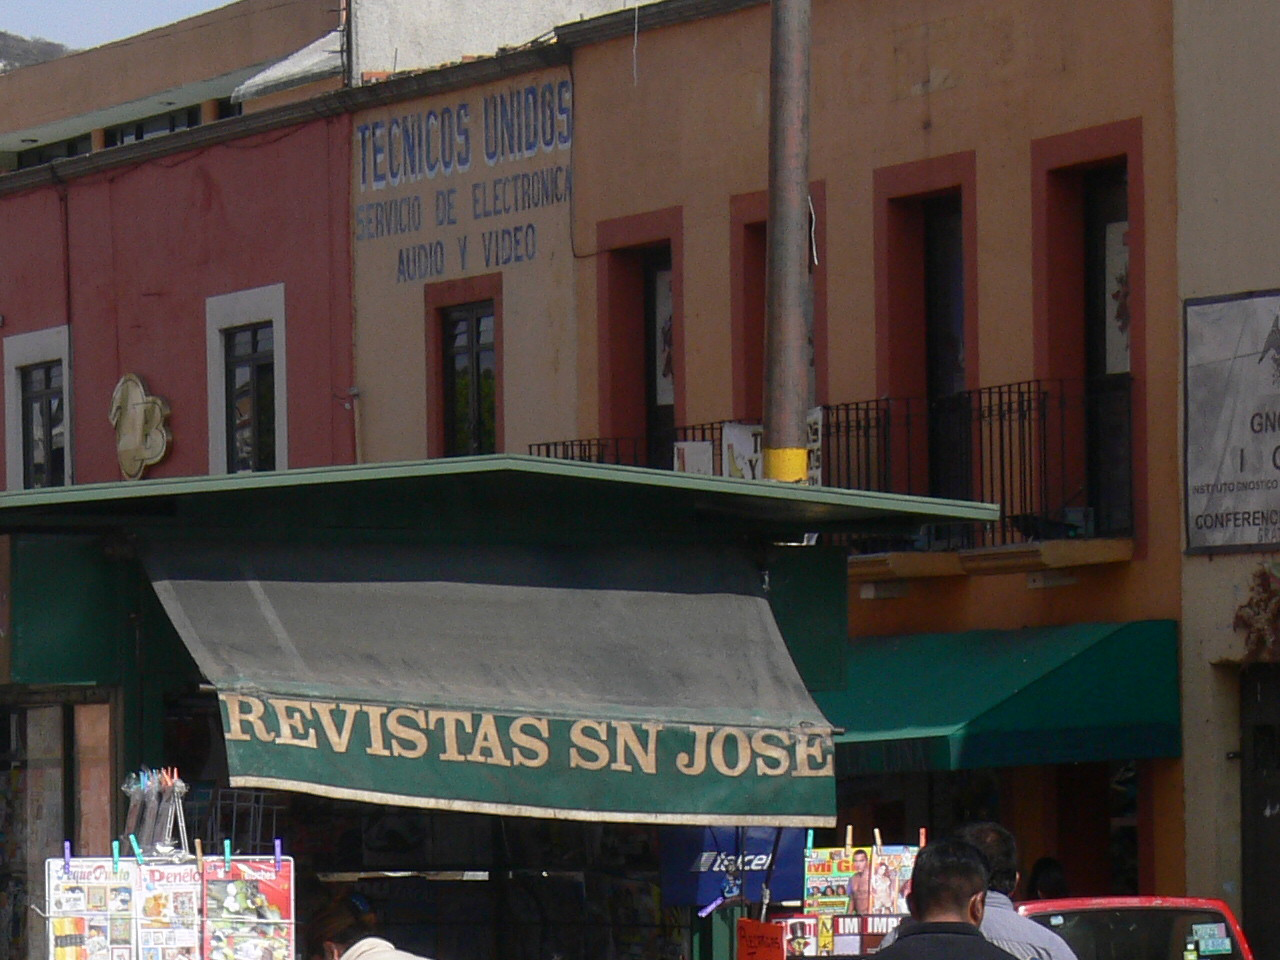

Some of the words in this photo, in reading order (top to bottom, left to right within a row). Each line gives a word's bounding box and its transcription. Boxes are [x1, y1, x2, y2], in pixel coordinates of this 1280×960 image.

[357, 104, 471, 192] TECNICOS
[484, 80, 572, 167] UNIDOS
[356, 196, 422, 240] SERVICIO
[435, 188, 457, 226] DE
[472, 165, 572, 219] ELECTRONICA
[397, 240, 445, 283] AUDIO
[458, 235, 468, 270] Y
[483, 223, 537, 268] VIDEO
[1195, 509, 1280, 529] CONFERENC
[219, 692, 550, 769] REVISTAS
[569, 718, 663, 775] SN
[676, 724, 835, 778] JOSE
[149, 867, 201, 884] Penélo
